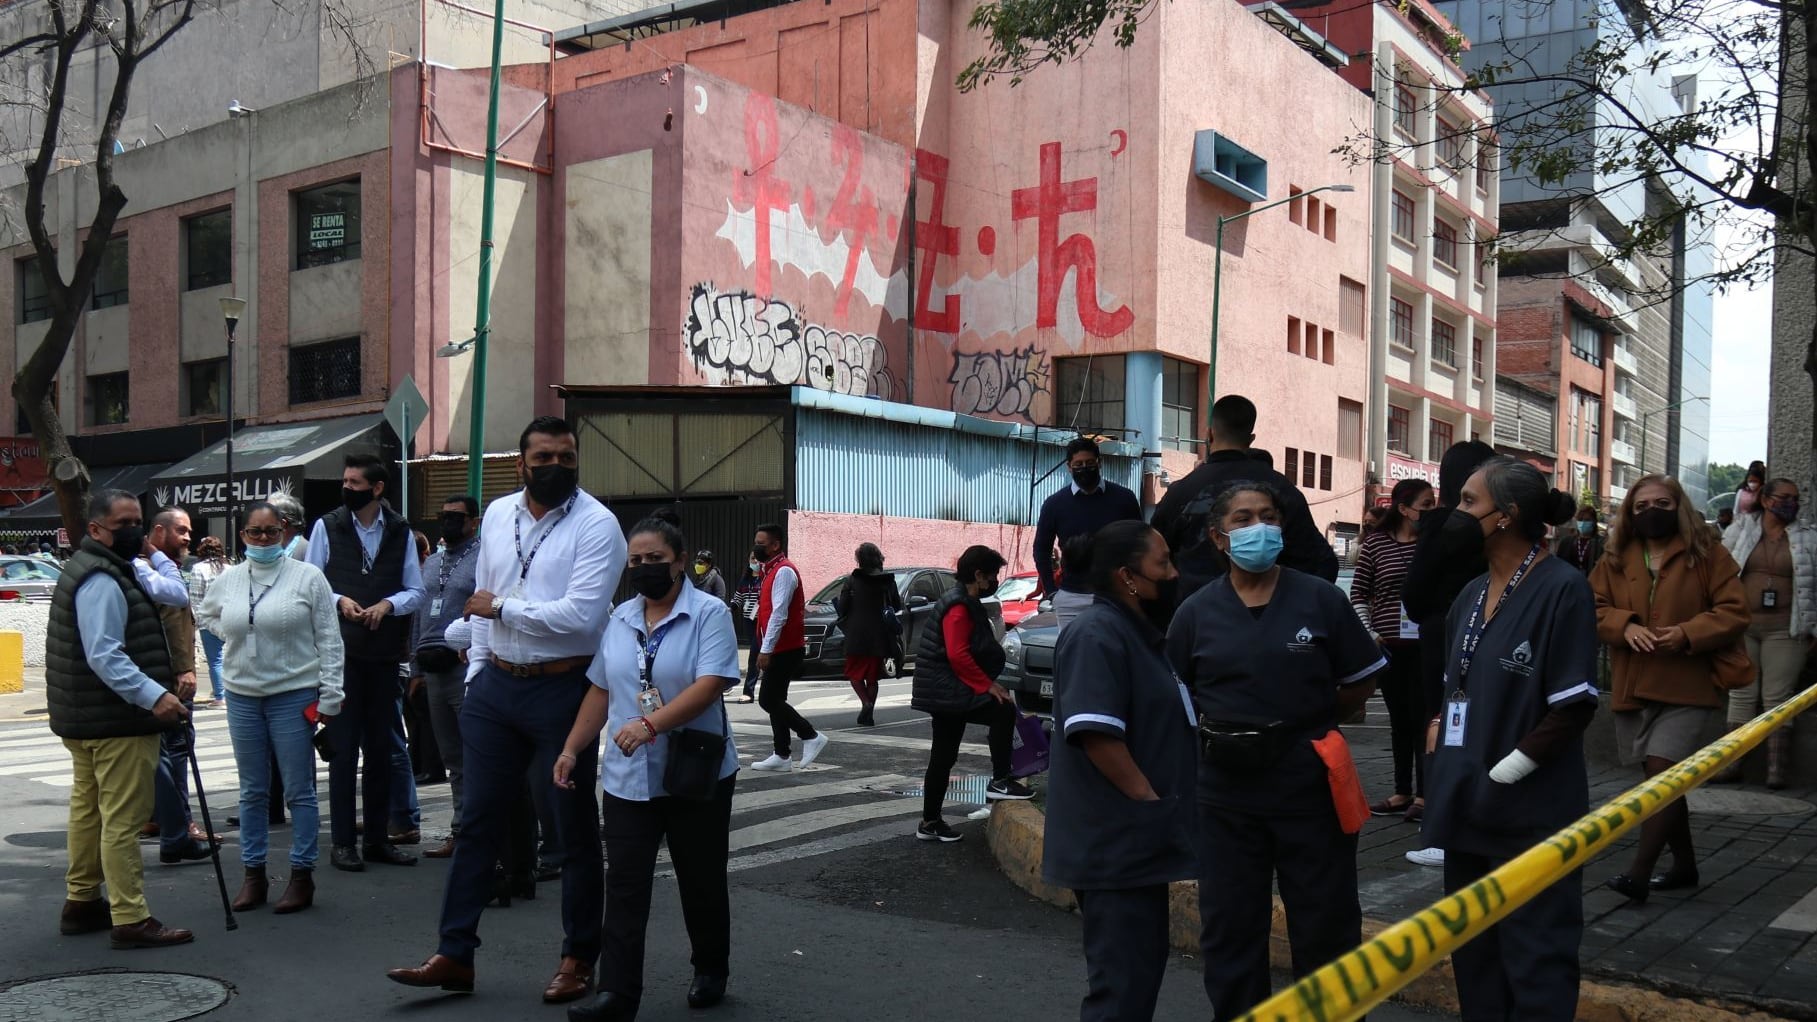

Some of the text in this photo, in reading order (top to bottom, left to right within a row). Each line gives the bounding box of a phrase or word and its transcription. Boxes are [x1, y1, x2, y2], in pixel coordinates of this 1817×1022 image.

[312, 214, 344, 229] SE RENTA
[312, 230, 343, 238] LOCAL
[174, 478, 273, 505] MEZCALLI
[1510, 569, 1522, 586] SAT
[1524, 550, 1536, 566] SAT
[1468, 611, 1478, 628] SAT
[1462, 633, 1470, 652] SAT
[1469, 634, 1480, 652] SAT
